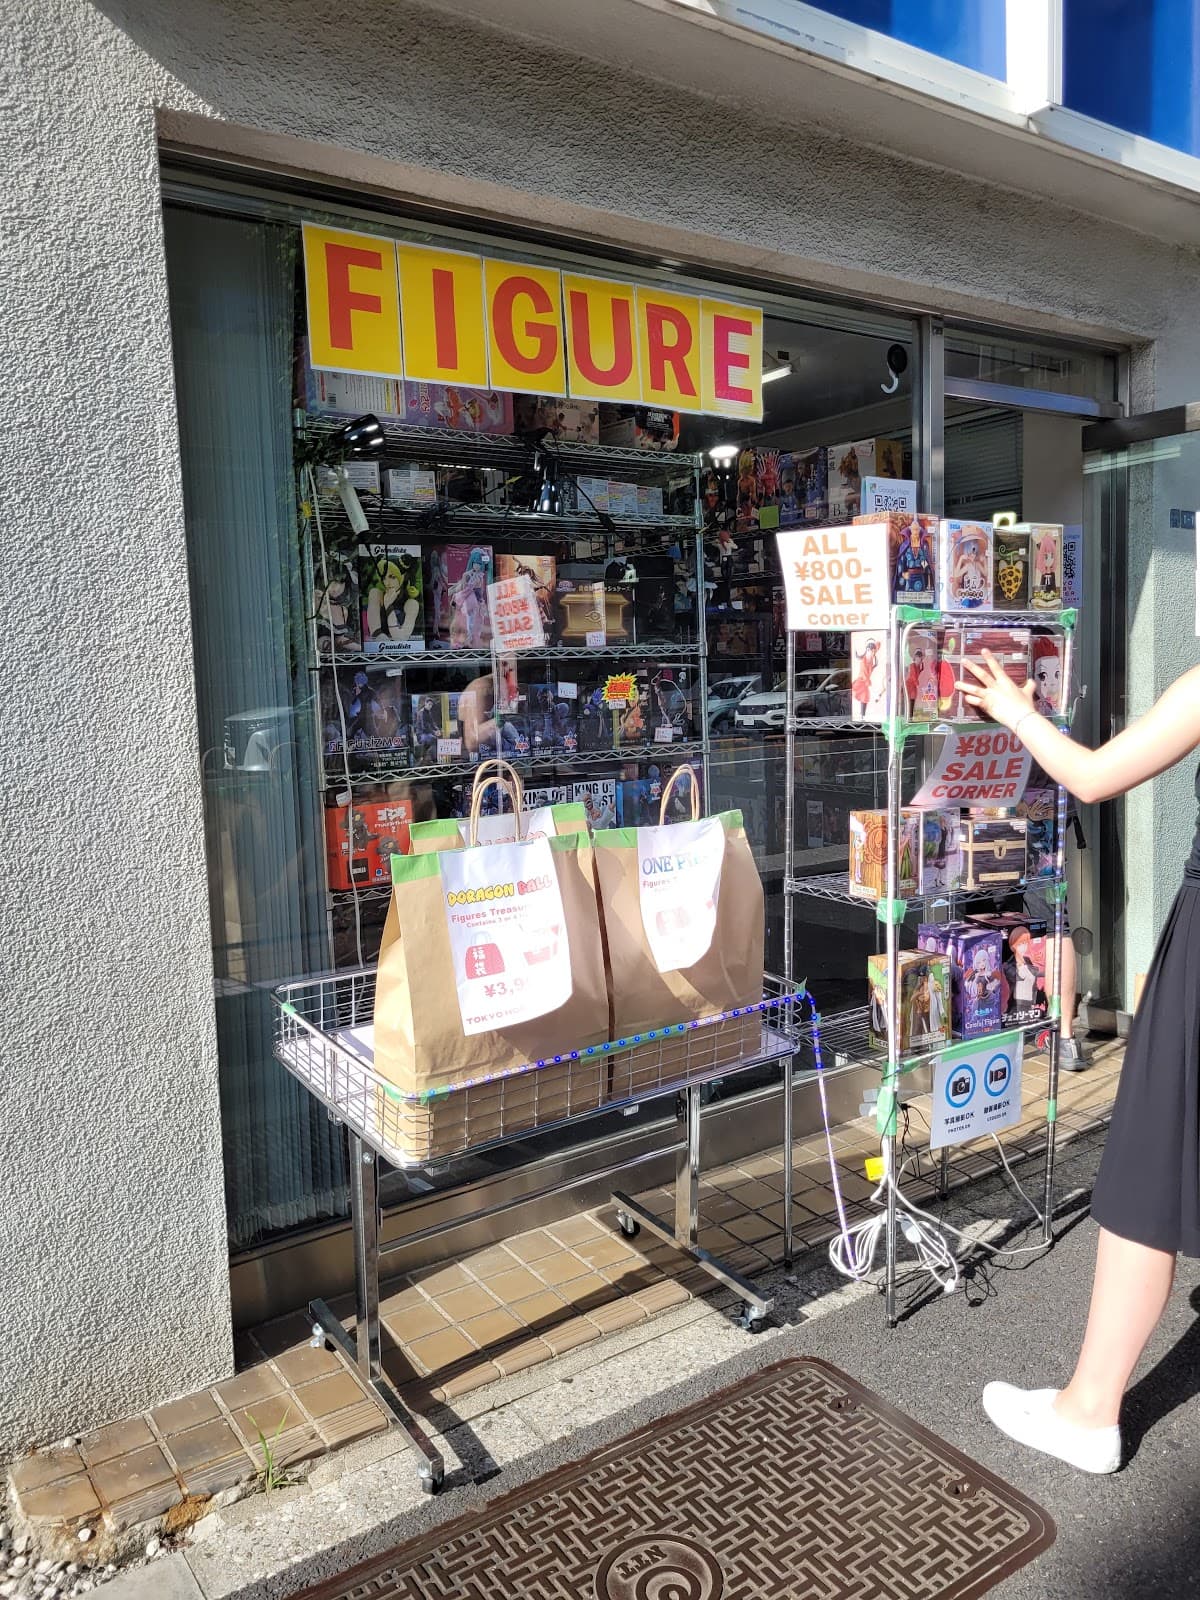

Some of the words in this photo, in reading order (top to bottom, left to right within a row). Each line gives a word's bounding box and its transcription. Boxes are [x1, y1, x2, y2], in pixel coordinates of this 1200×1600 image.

[325, 243, 753, 404] FIGURE
[803, 532, 857, 556] ALL
[793, 558, 872, 581] ¥800-
[800, 583, 873, 606] SALE
[808, 613, 869, 625] coner
[942, 757, 1024, 781] SALE
[932, 783, 1016, 799] CORNER
[642, 856, 674, 875] ONE
[447, 882, 515, 907] DORAGON
[517, 875, 553, 895] BALL
[451, 911, 487, 923] Figures
[472, 946, 488, 976] 福袋
[466, 1010, 503, 1025] TOKYO
[1002, 1009, 1041, 1023] チェンソーマン
[615, 1544, 668, 1580] NTT
